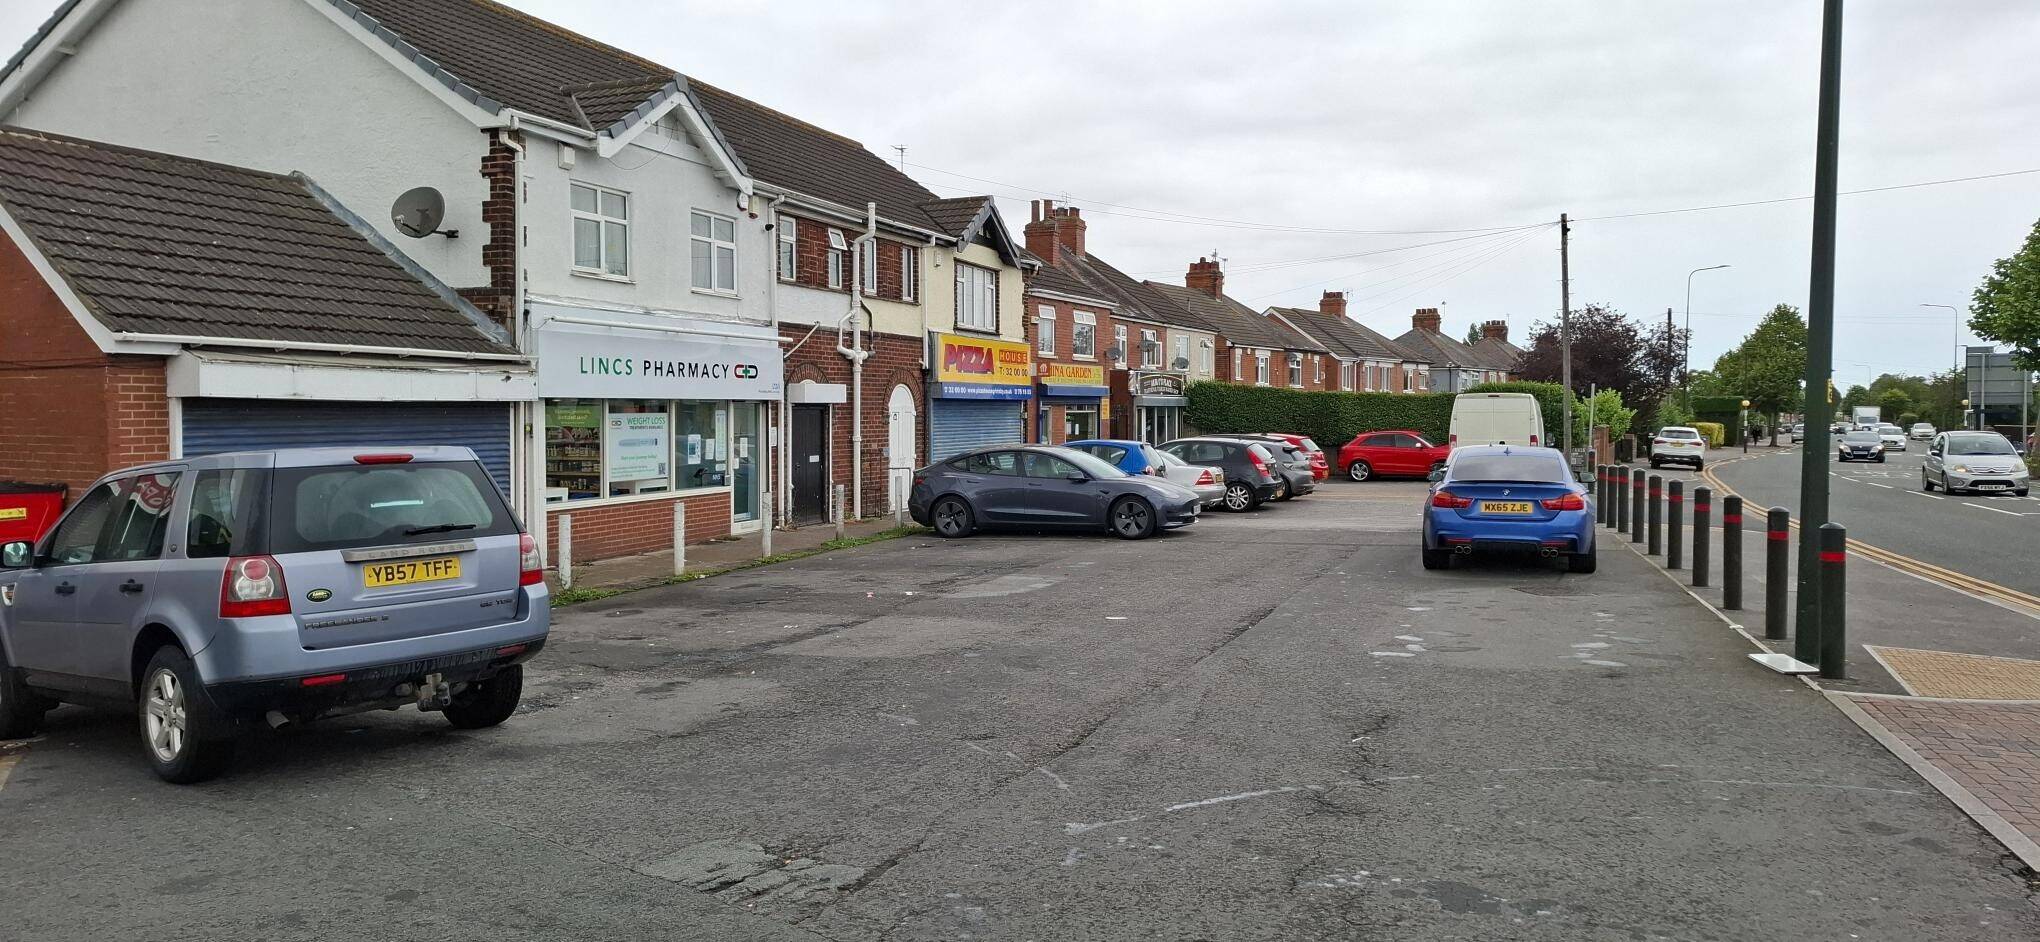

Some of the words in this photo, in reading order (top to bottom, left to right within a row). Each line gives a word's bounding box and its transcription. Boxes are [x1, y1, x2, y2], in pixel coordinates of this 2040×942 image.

[944, 343, 995, 375] PIZZA
[1000, 351, 1027, 363] HOUSE
[580, 356, 633, 376] LINCS
[643, 360, 729, 379] PHARMACY
[1006, 368, 1012, 376] 32
[1014, 368, 1020, 376] 00
[1022, 369, 1028, 377] 00
[1066, 366, 1092, 379] GARDEN
[627, 416, 650, 425] WEIGHT
[651, 416, 665, 425] LOSS
[1484, 503, 1508, 512] MX65
[1510, 503, 1529, 512] ZJE
[368, 549, 408, 559] LAND
[418, 544, 465, 555] ROVER
[371, 564, 418, 583] YB57
[422, 559, 453, 578] TFF
